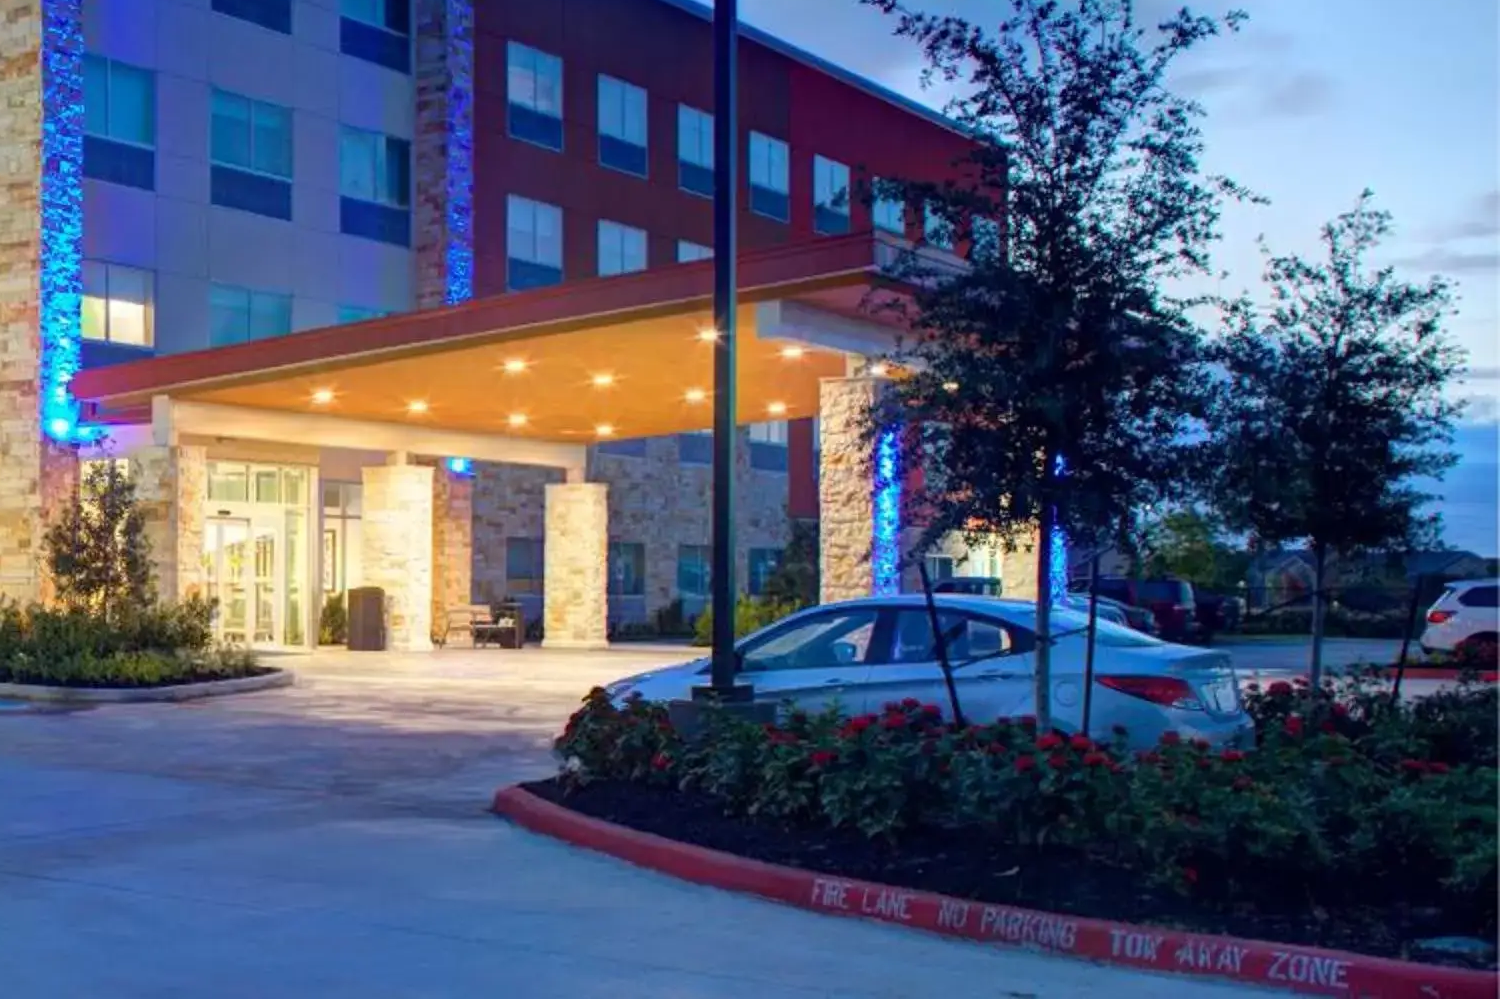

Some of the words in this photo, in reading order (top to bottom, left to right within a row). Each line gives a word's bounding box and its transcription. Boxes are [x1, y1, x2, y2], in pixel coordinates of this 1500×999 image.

[810, 878, 851, 910] FIRE
[861, 887, 913, 920] LANE
[937, 899, 971, 928] NO
[980, 903, 1079, 949] PARKING
[1110, 928, 1164, 962] TOW
[1175, 937, 1250, 973] AWAY
[1267, 951, 1354, 989] ZONE
